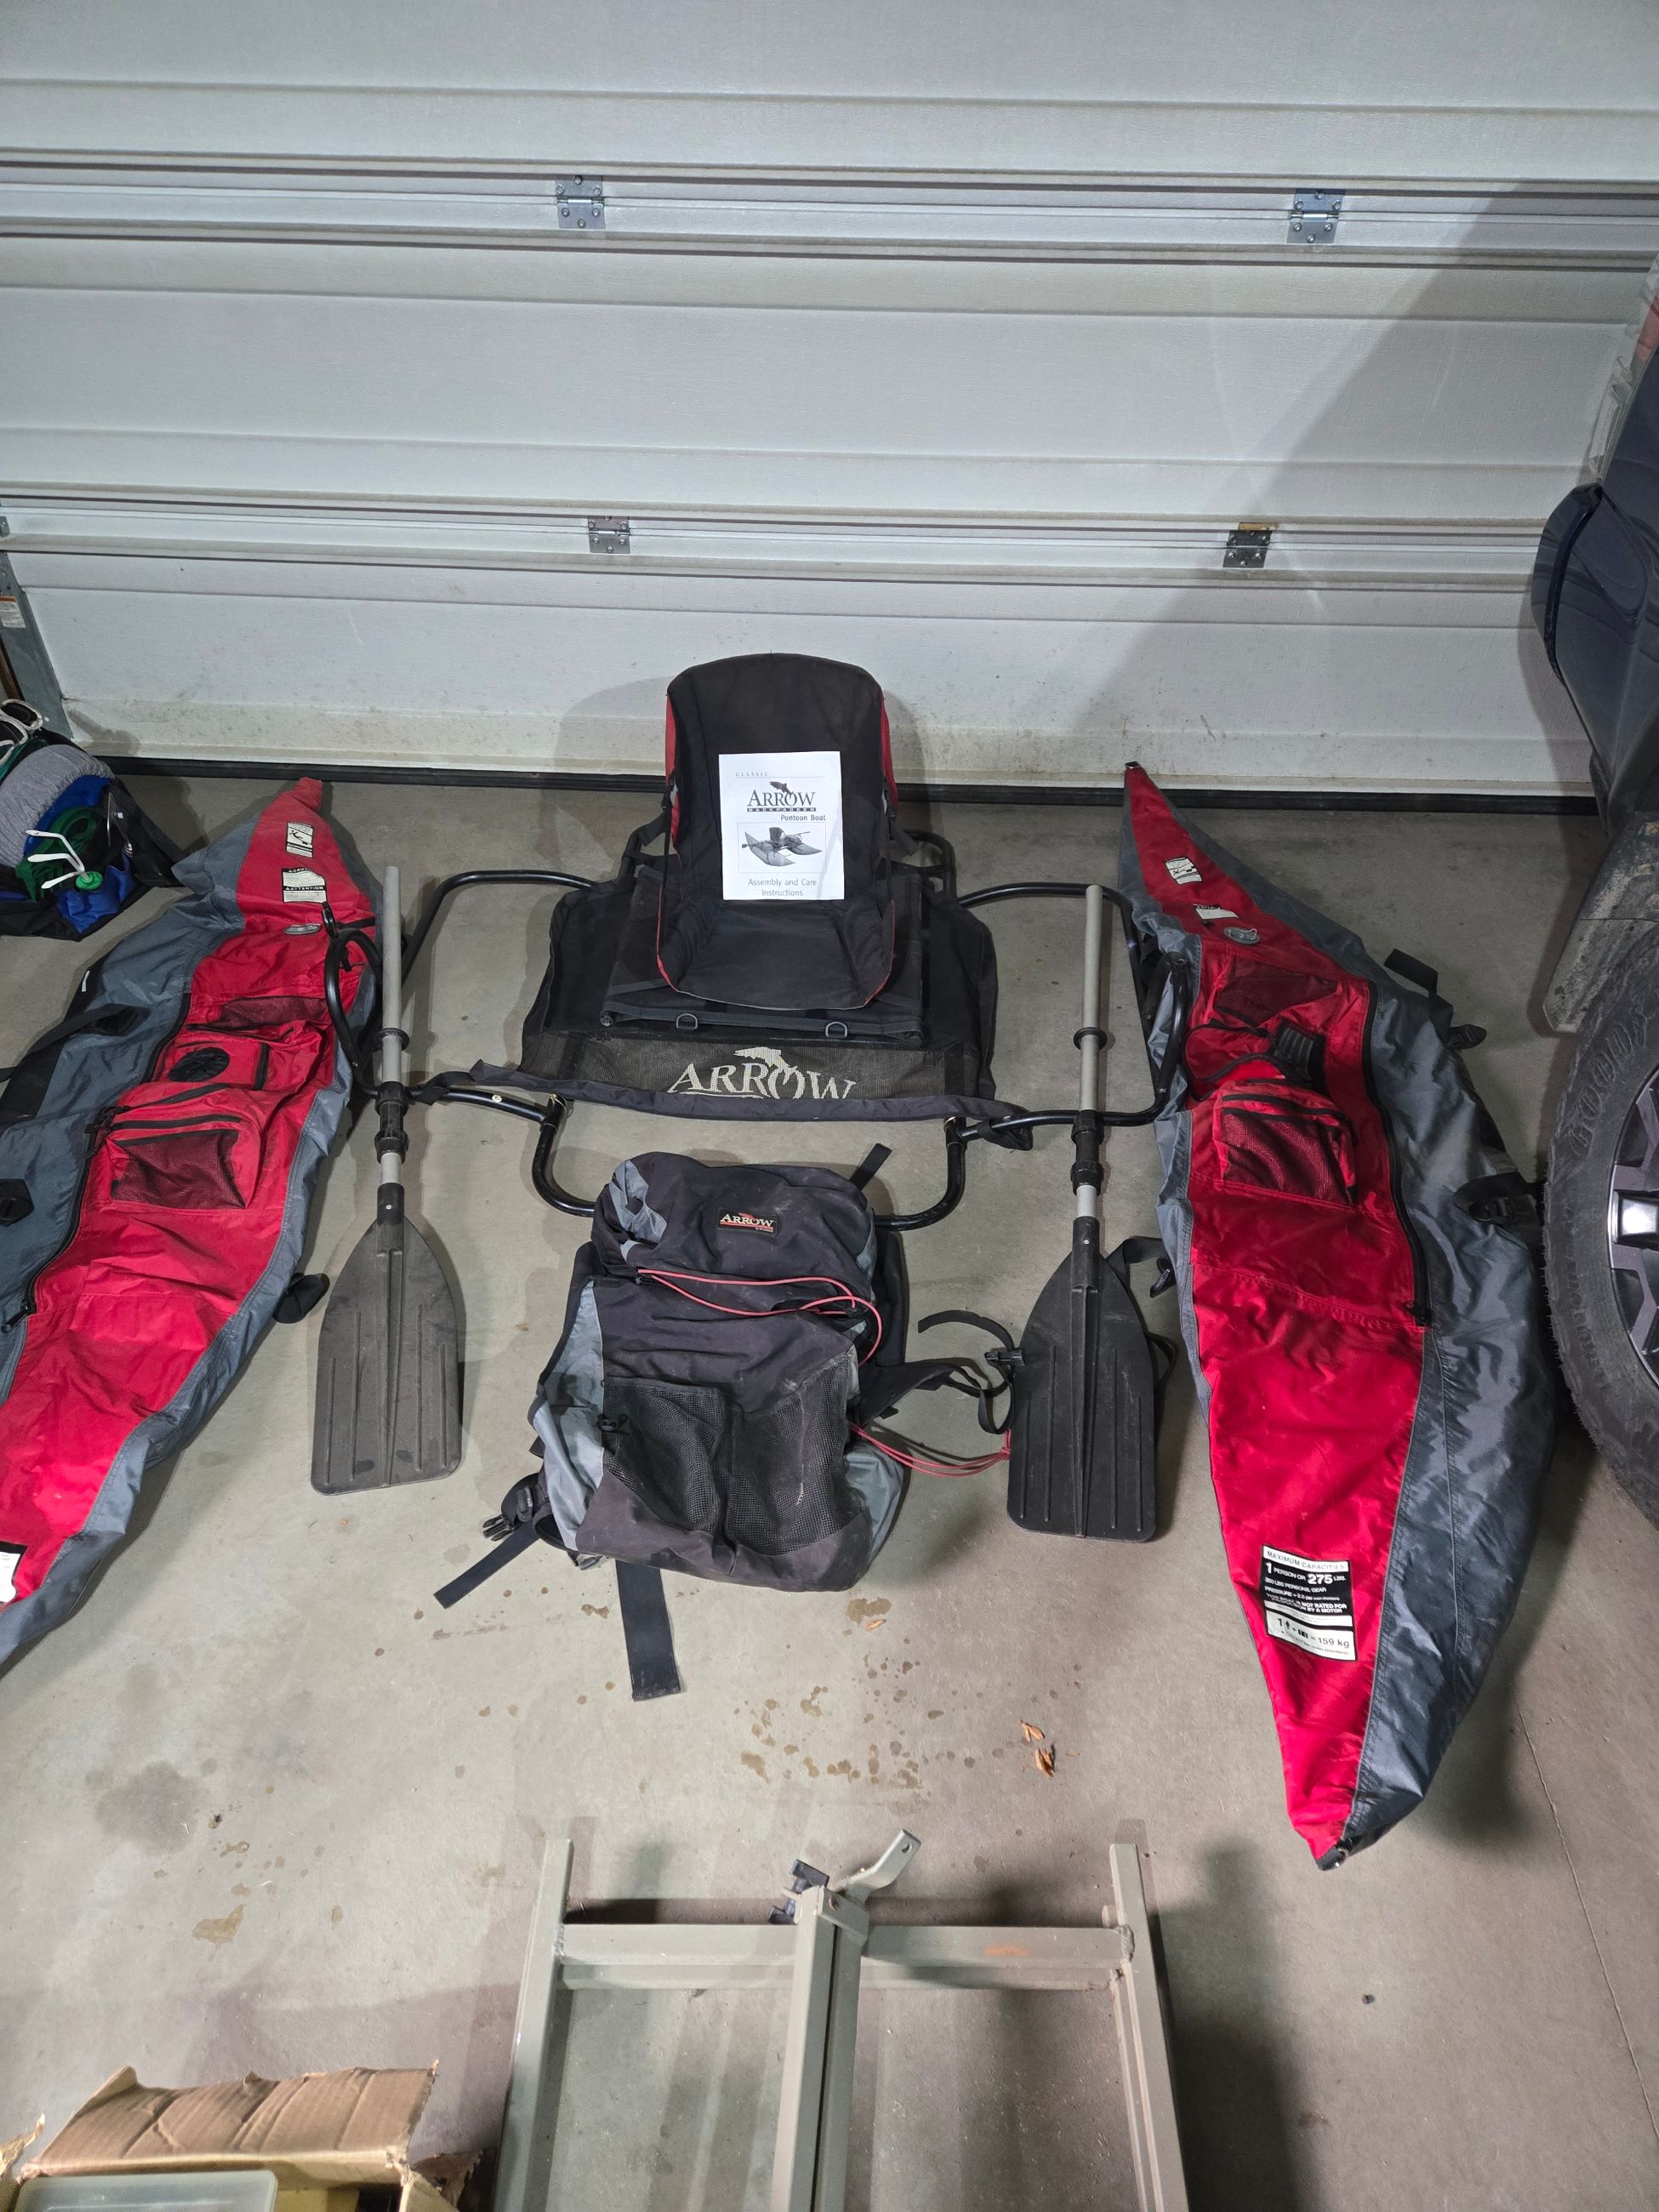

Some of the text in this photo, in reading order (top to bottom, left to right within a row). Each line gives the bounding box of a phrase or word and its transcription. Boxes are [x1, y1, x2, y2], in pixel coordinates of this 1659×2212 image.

[747, 789, 816, 807] ARROW
[748, 878, 782, 887] Assembly
[801, 878, 818, 887] Care
[667, 1062, 857, 1100] ARROW
[720, 1213, 775, 1228] ARROW
[1267, 1550, 1345, 1570] MAXIMUM CAPACITIES
[1266, 1562, 1272, 1573] 1
[1274, 1567, 1297, 1579] PERSON
[1307, 1573, 1333, 1584] 275
[1264, 1586, 1292, 1597] PRESSURE
[1318, 1637, 1335, 1645] 159
[1337, 1639, 1349, 1649] kg
